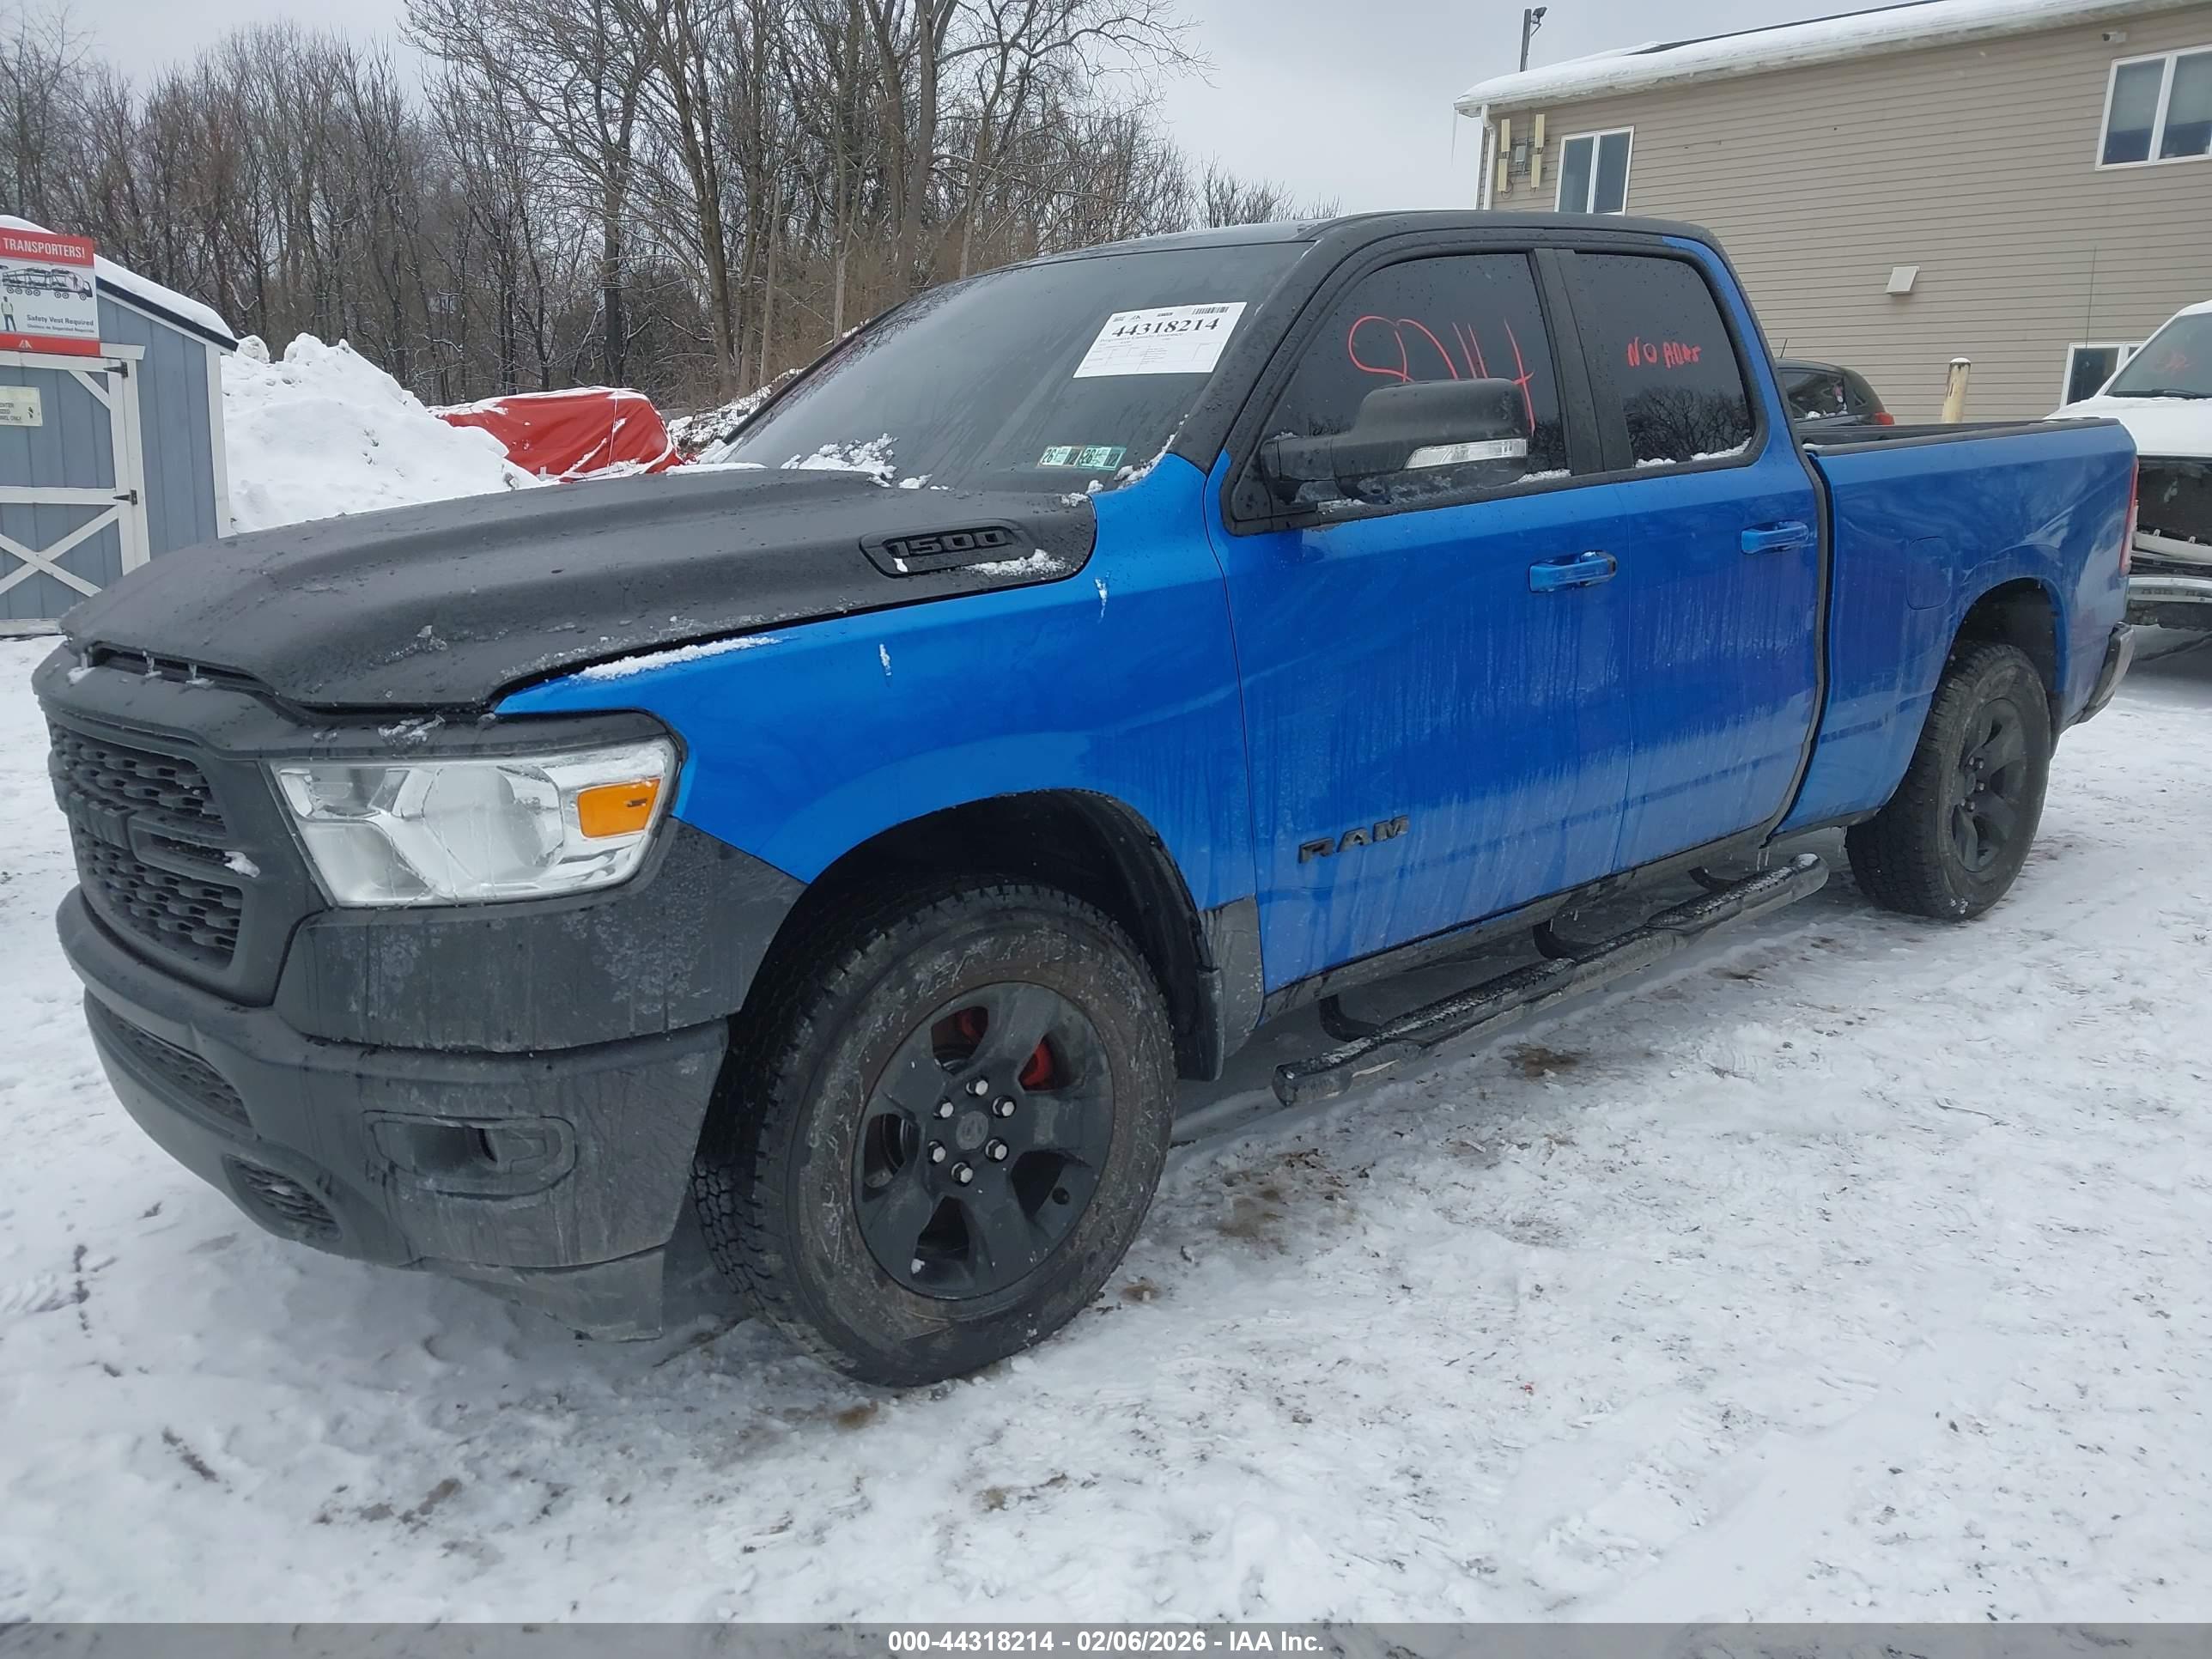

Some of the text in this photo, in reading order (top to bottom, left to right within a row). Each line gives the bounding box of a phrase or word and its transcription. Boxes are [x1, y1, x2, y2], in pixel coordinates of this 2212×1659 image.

[3, 238, 85, 258] TRANSPORTERS!
[27, 314, 47, 323] Safety
[64, 317, 94, 325] Required
[1111, 318, 1220, 337] 44318214
[1627, 337, 1657, 367] NO
[1042, 448, 1057, 463] 26
[887, 531, 1006, 558] 1500
[1297, 814, 1409, 864] RAM
